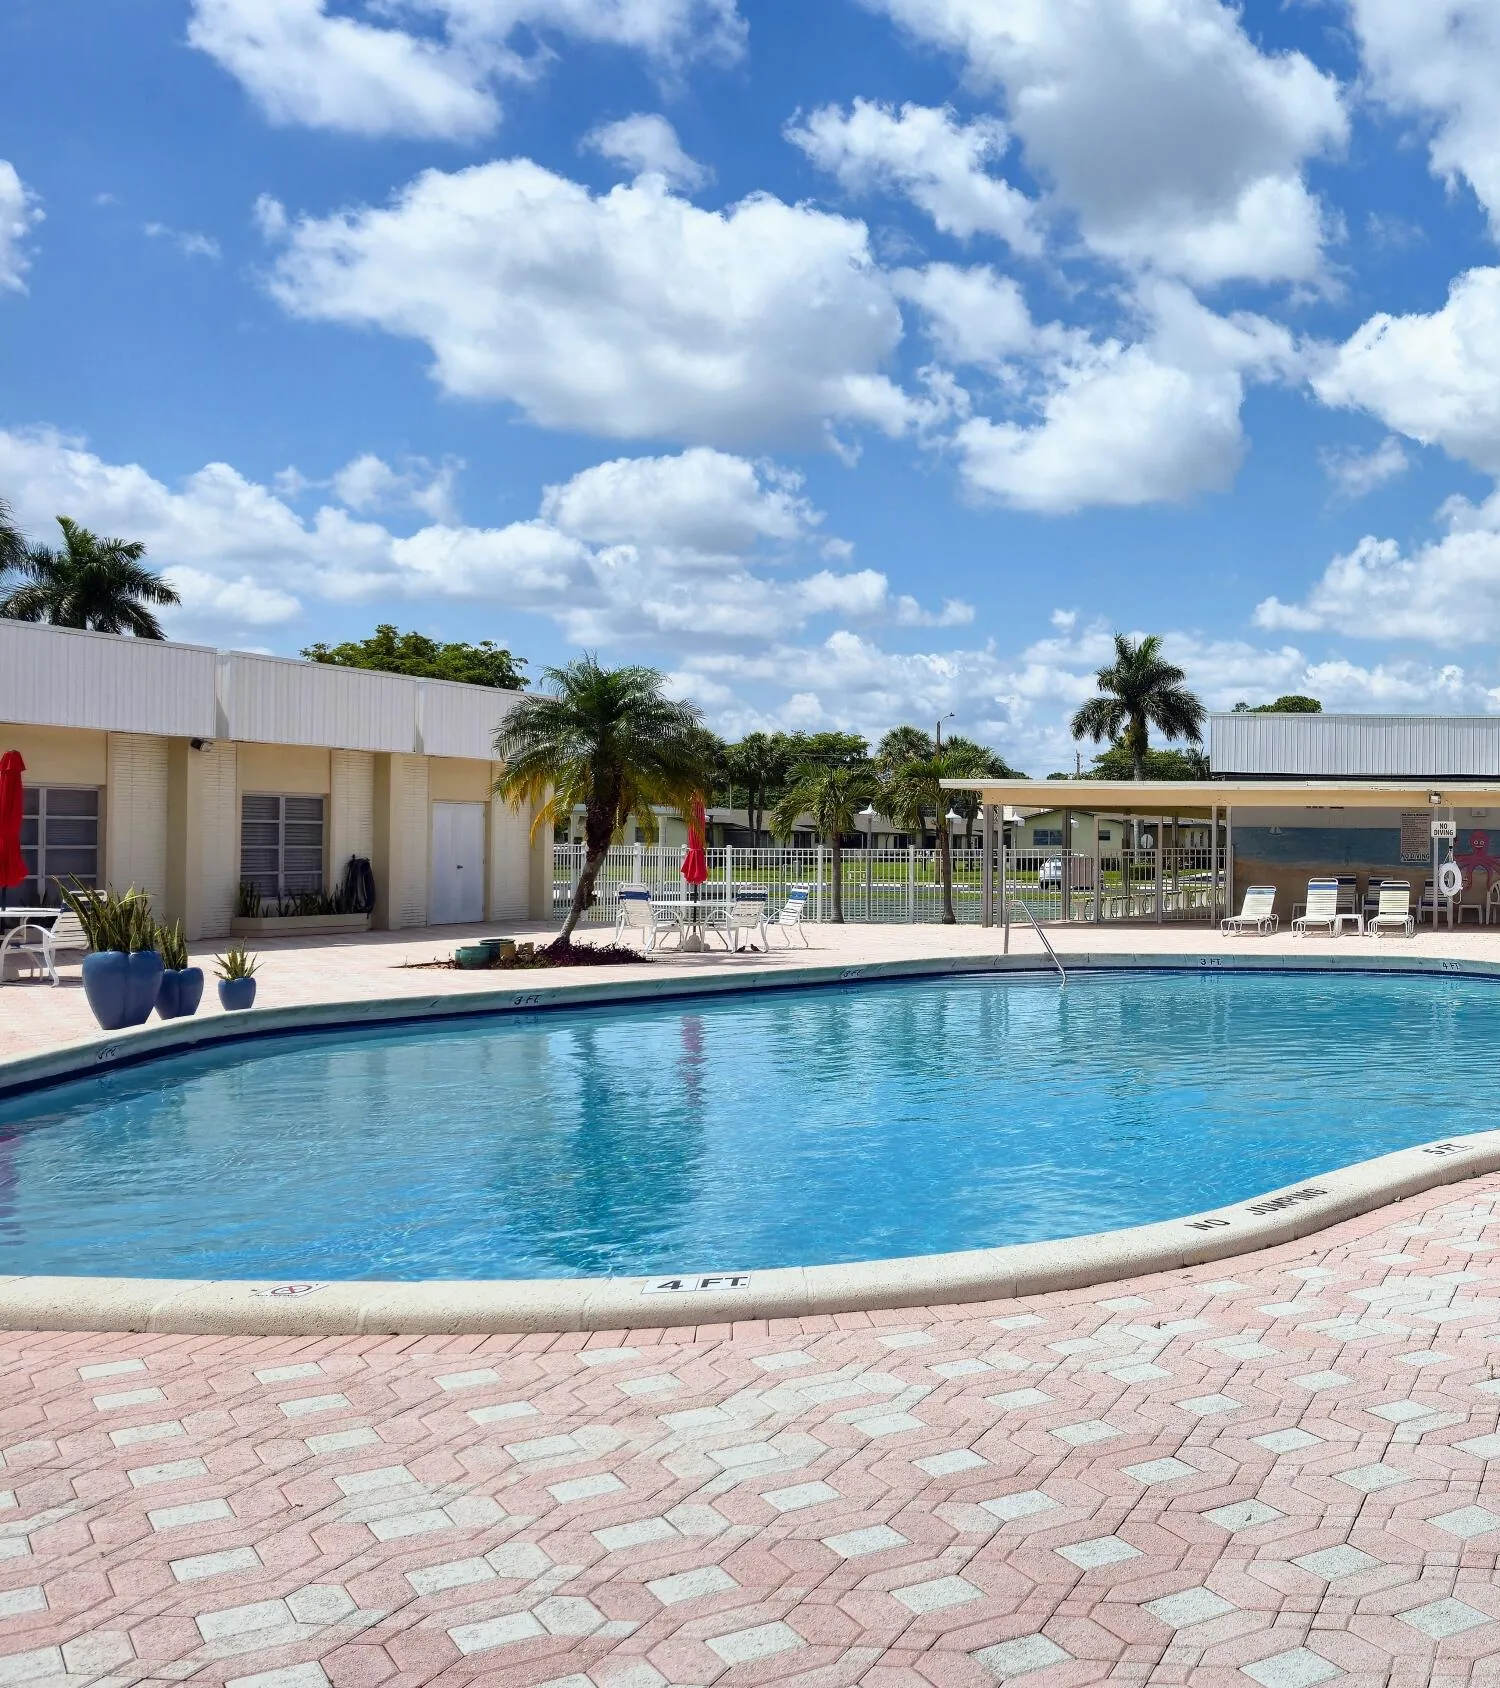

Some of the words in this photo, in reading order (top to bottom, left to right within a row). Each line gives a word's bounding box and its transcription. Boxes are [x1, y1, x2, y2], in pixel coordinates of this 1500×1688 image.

[1184, 1218, 1231, 1231] NO
[1245, 1188, 1328, 1216] JUMPING
[657, 1280, 684, 1290] 4
[700, 1276, 749, 1289] FT.
